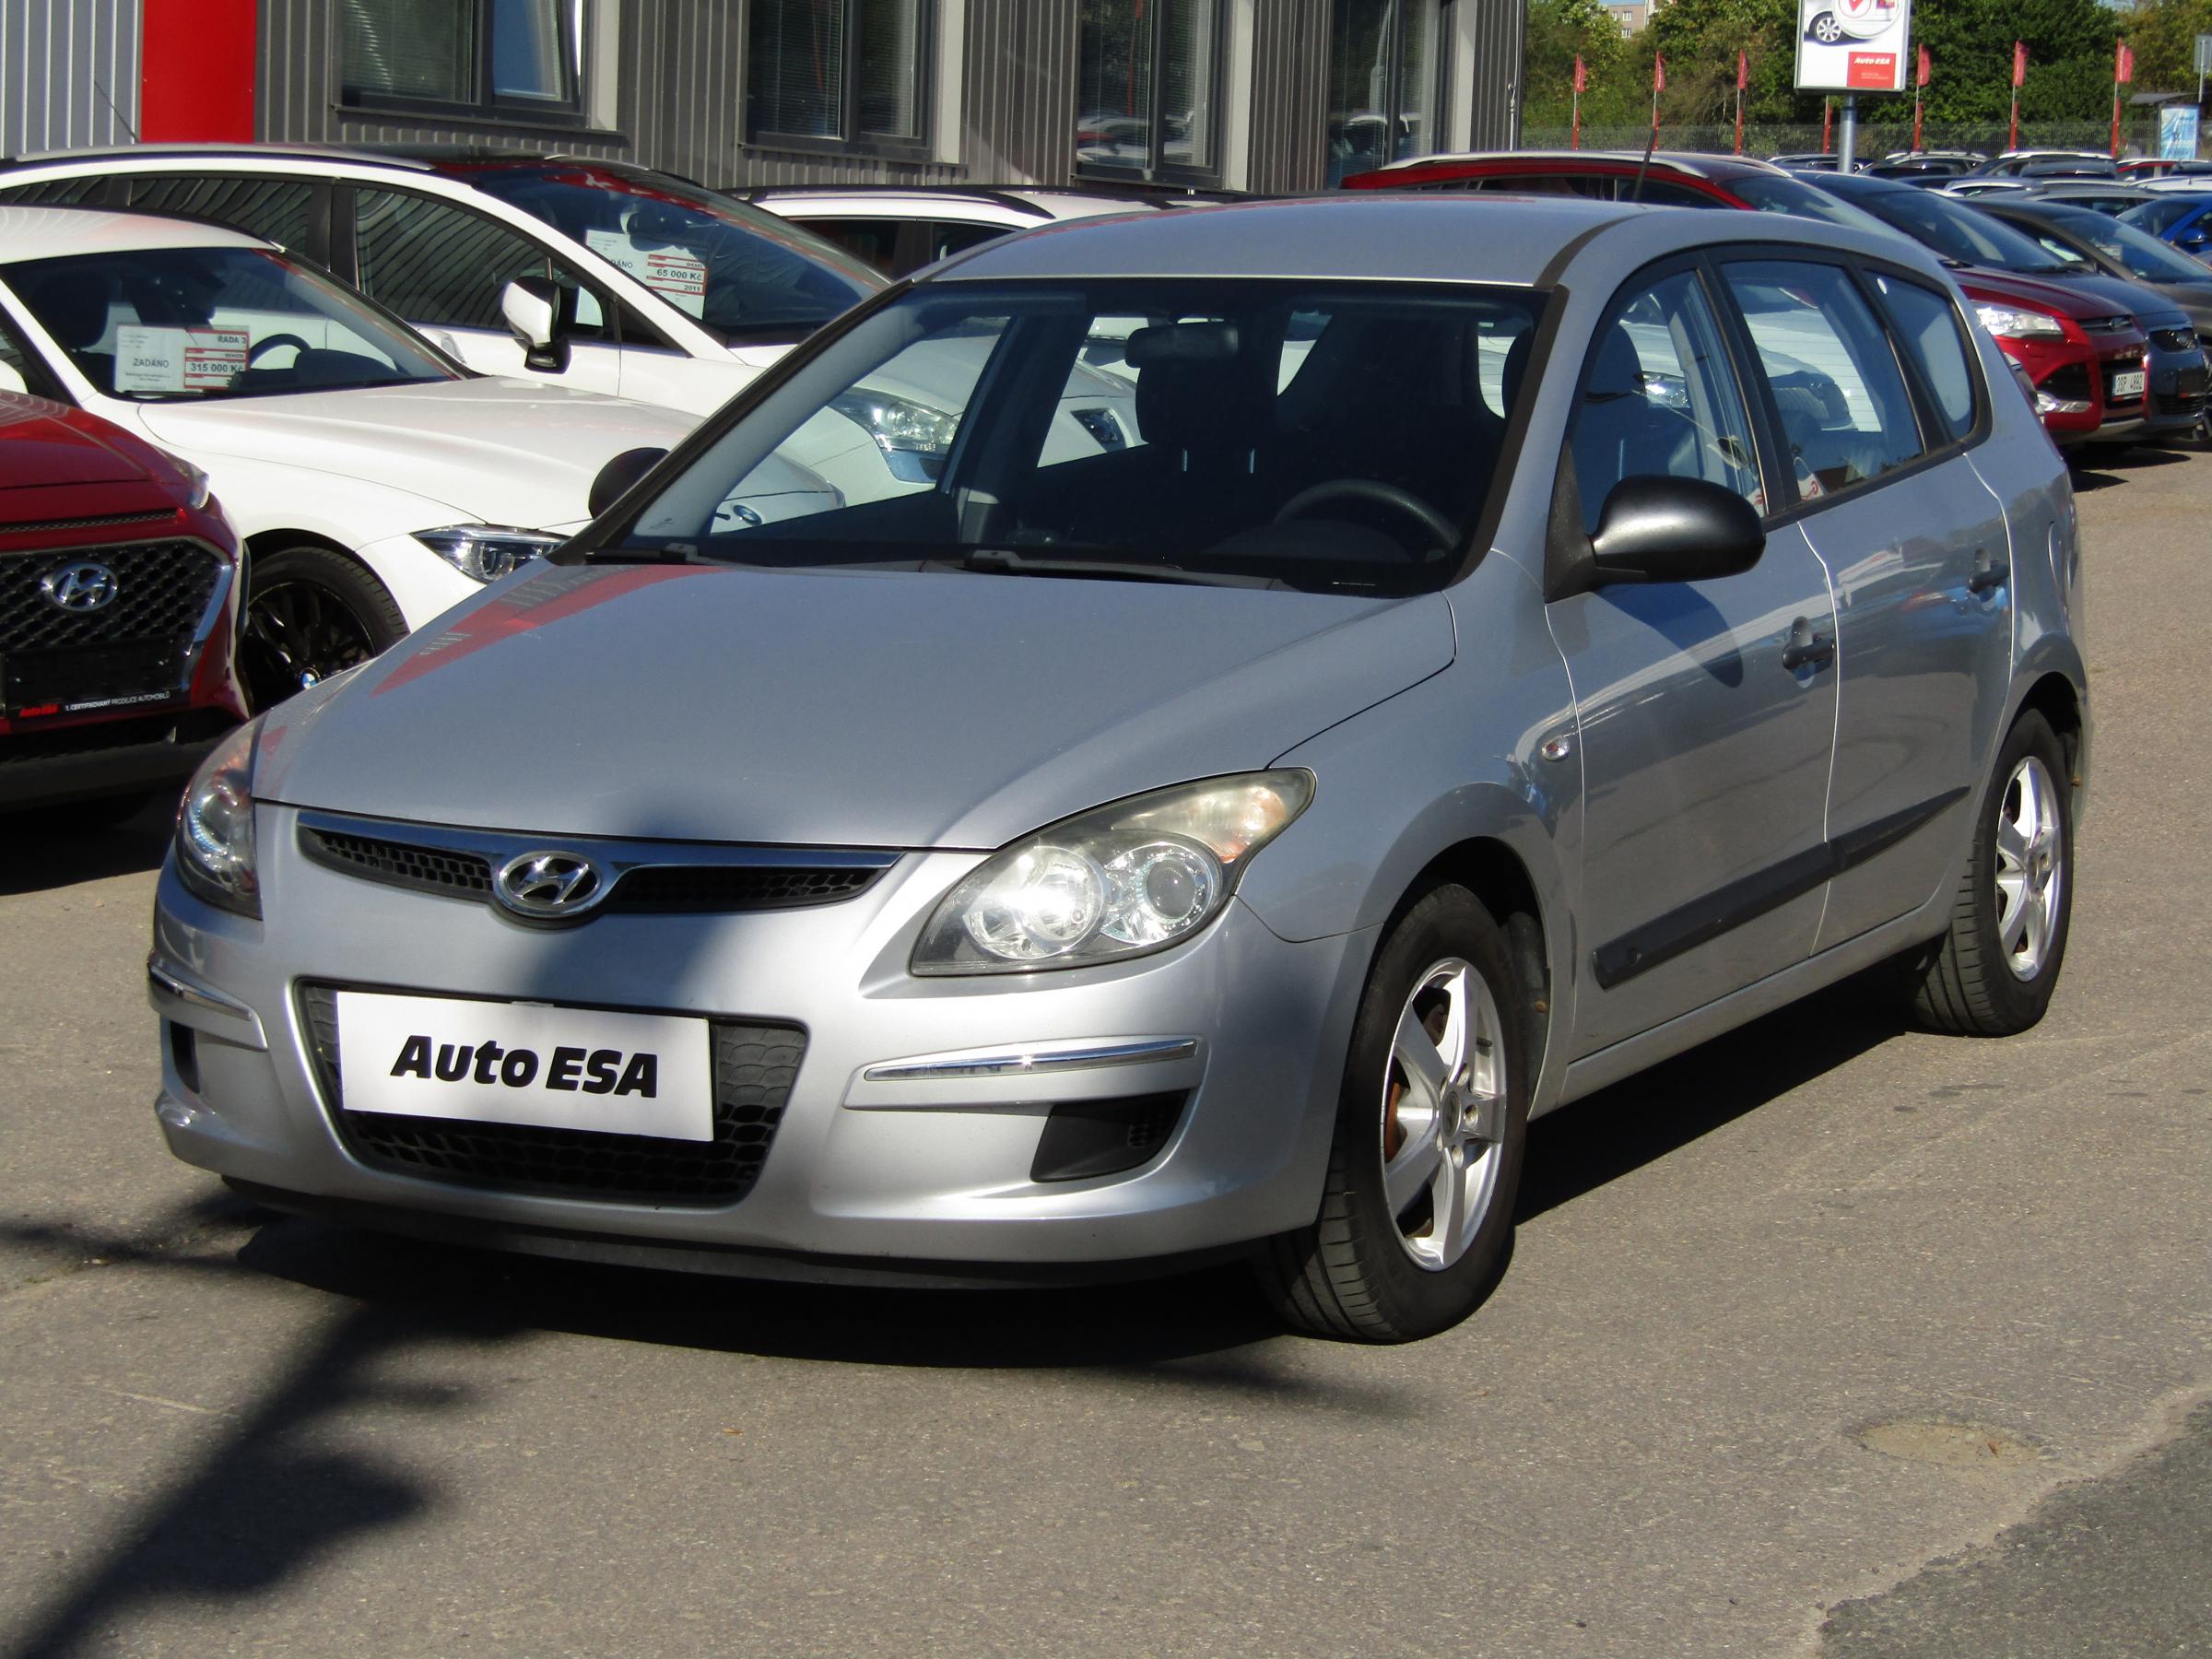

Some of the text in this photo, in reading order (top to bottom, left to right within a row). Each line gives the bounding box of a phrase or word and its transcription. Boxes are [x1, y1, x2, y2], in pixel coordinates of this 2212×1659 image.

[656, 268, 668, 277] 65
[670, 269, 688, 279] 000
[689, 272, 702, 281] Kč
[133, 358, 170, 368] ZADÁNO
[190, 362, 208, 372] 315
[210, 363, 229, 372] 000
[390, 1035, 658, 1098] Auto ESA
